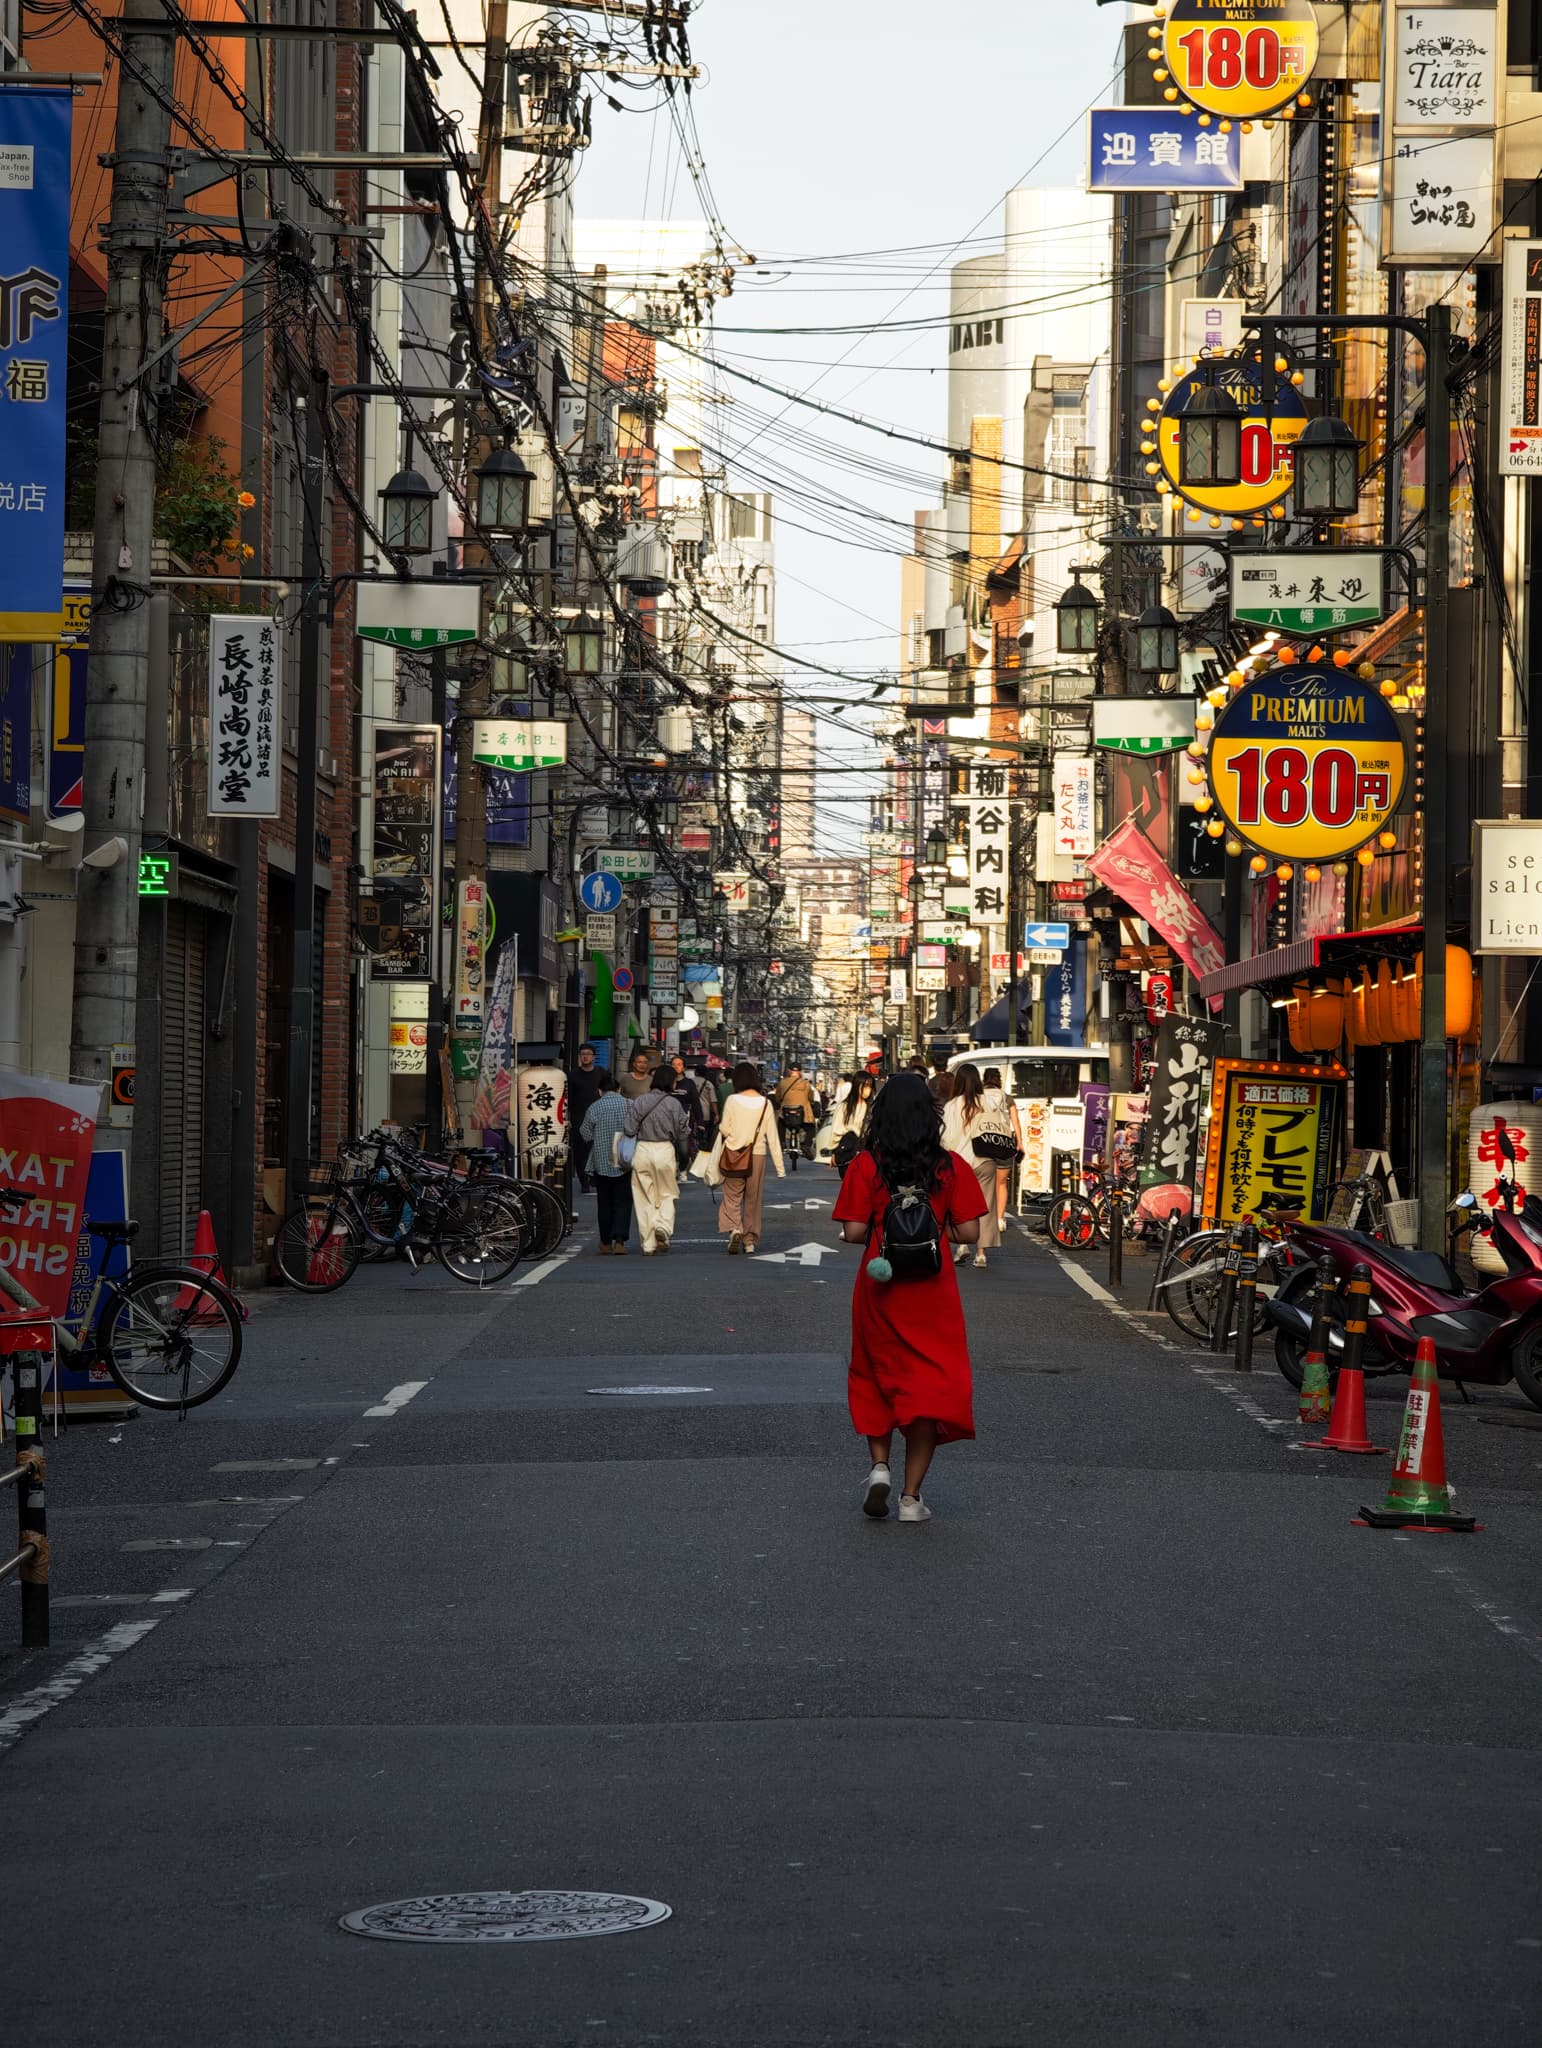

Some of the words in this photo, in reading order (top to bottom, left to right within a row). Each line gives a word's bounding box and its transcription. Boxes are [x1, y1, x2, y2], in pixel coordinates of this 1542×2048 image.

[1406, 15, 1422, 30] 1F
[1178, 27, 1306, 89] 180円
[1453, 59, 1469, 68] Bar
[1408, 59, 1482, 89] Tiara
[1101, 131, 1230, 167] 迎賓館
[8, 173, 31, 181] Shop
[1205, 308, 1222, 347] 白馬
[0, 360, 48, 400] 福
[1268, 609, 1346, 624] 八幡筋
[384, 627, 449, 643] 八幡筋
[1280, 672, 1337, 697] The
[218, 634, 254, 803] 長崎尚玩堂
[1250, 693, 1367, 724] PREMIUM
[1288, 724, 1326, 738] MALT'S
[1226, 746, 1391, 829] 180円
[1060, 783, 1074, 830] たく丸
[974, 767, 1005, 914] 柳谷内科
[602, 855, 650, 868] 松田ビル
[1152, 982, 1168, 1003] ラーメ
[1244, 1085, 1310, 1104] 適正価格
[526, 1082, 557, 1144] 海鮮
[1161, 1042, 1209, 1182] 山形牛
[1230, 1104, 1258, 1214] 何時でも何杯飲んでも
